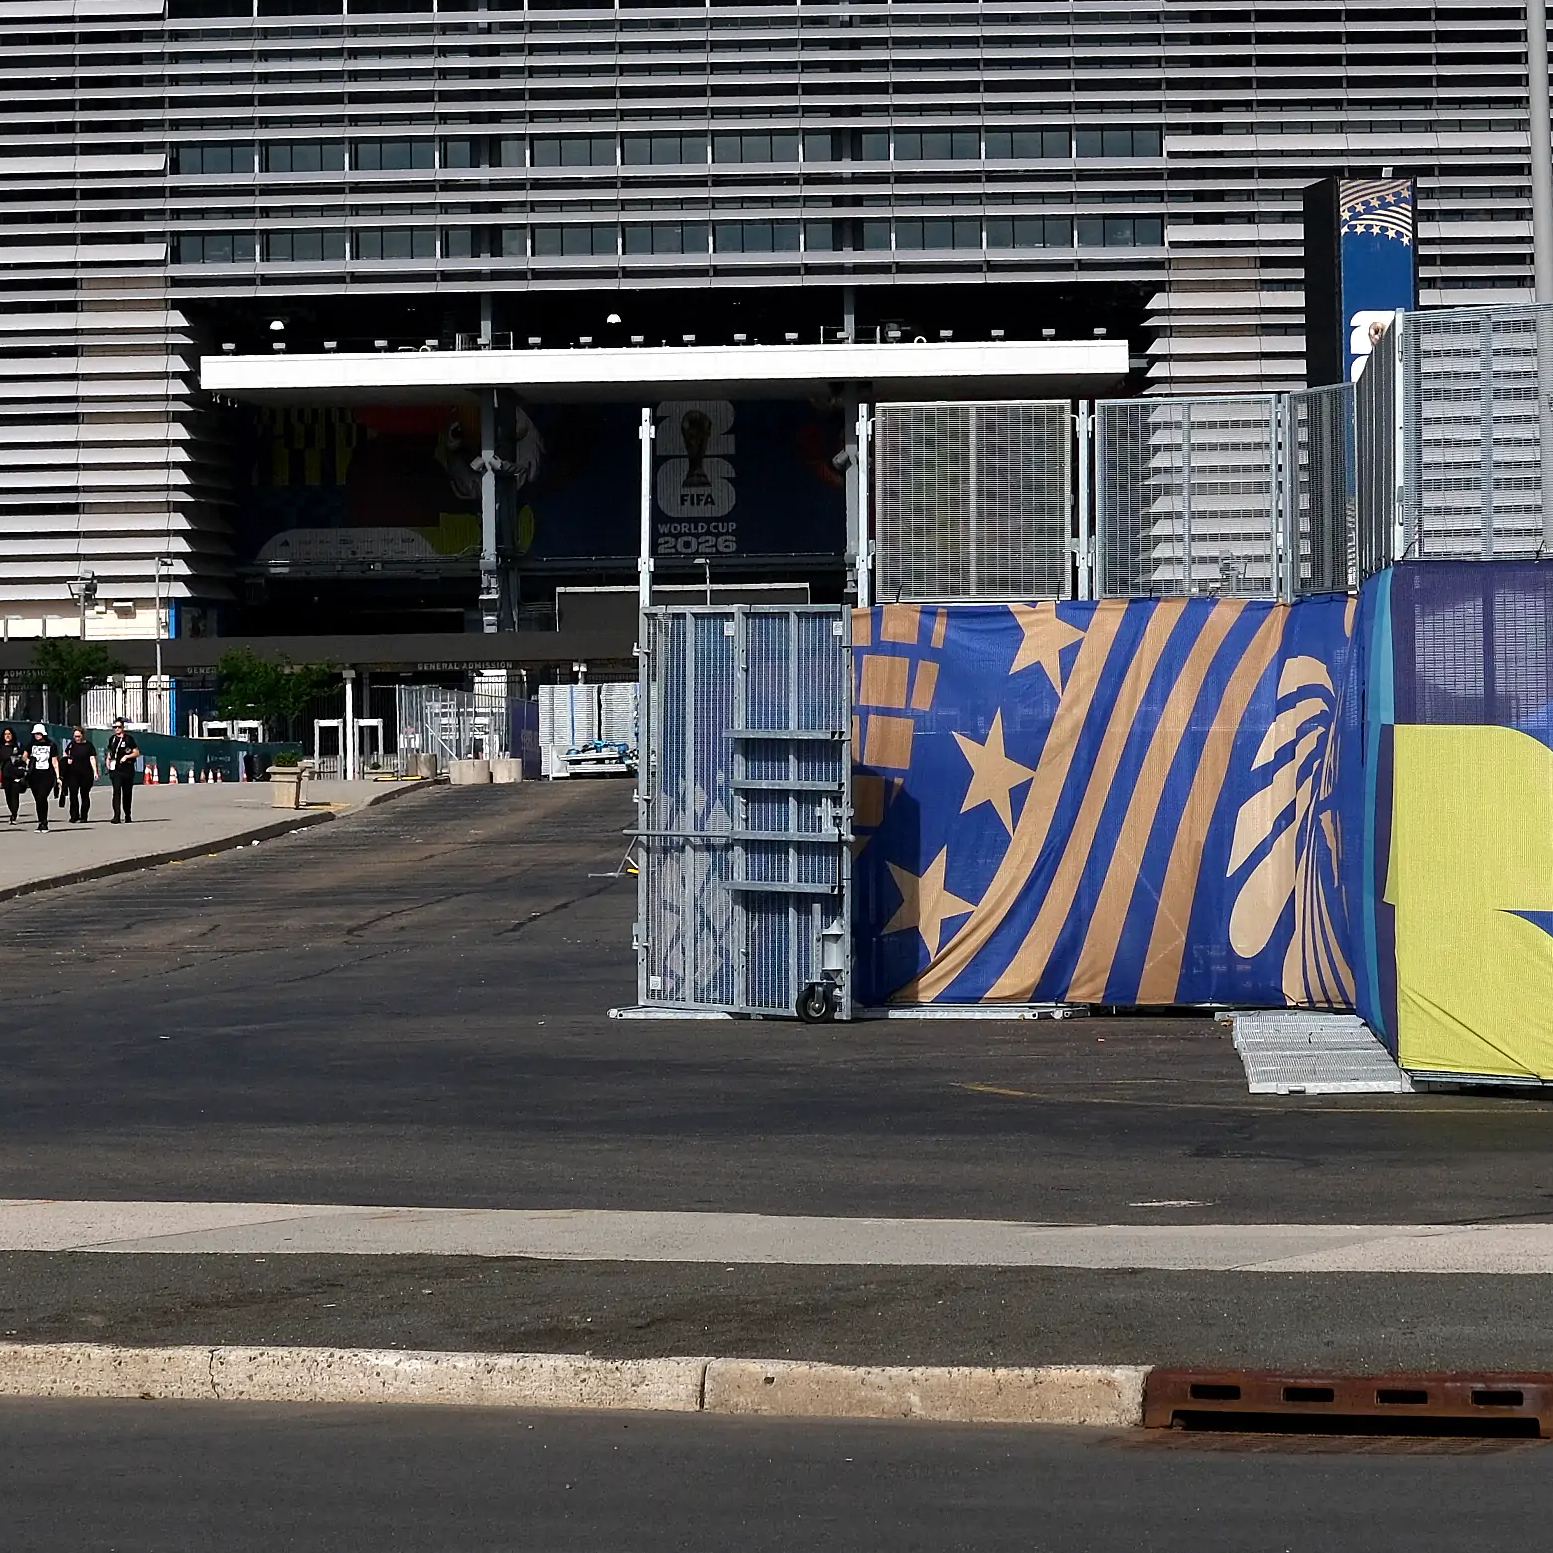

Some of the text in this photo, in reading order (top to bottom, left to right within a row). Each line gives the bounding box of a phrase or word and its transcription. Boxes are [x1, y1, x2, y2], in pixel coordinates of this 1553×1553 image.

[680, 493, 716, 506] FIFA
[657, 522, 737, 534] WORLD CUP
[657, 535, 737, 554] 2026
[417, 661, 513, 671] GENERAL ADMISSION
[3, 669, 47, 678] ADMISSIO
